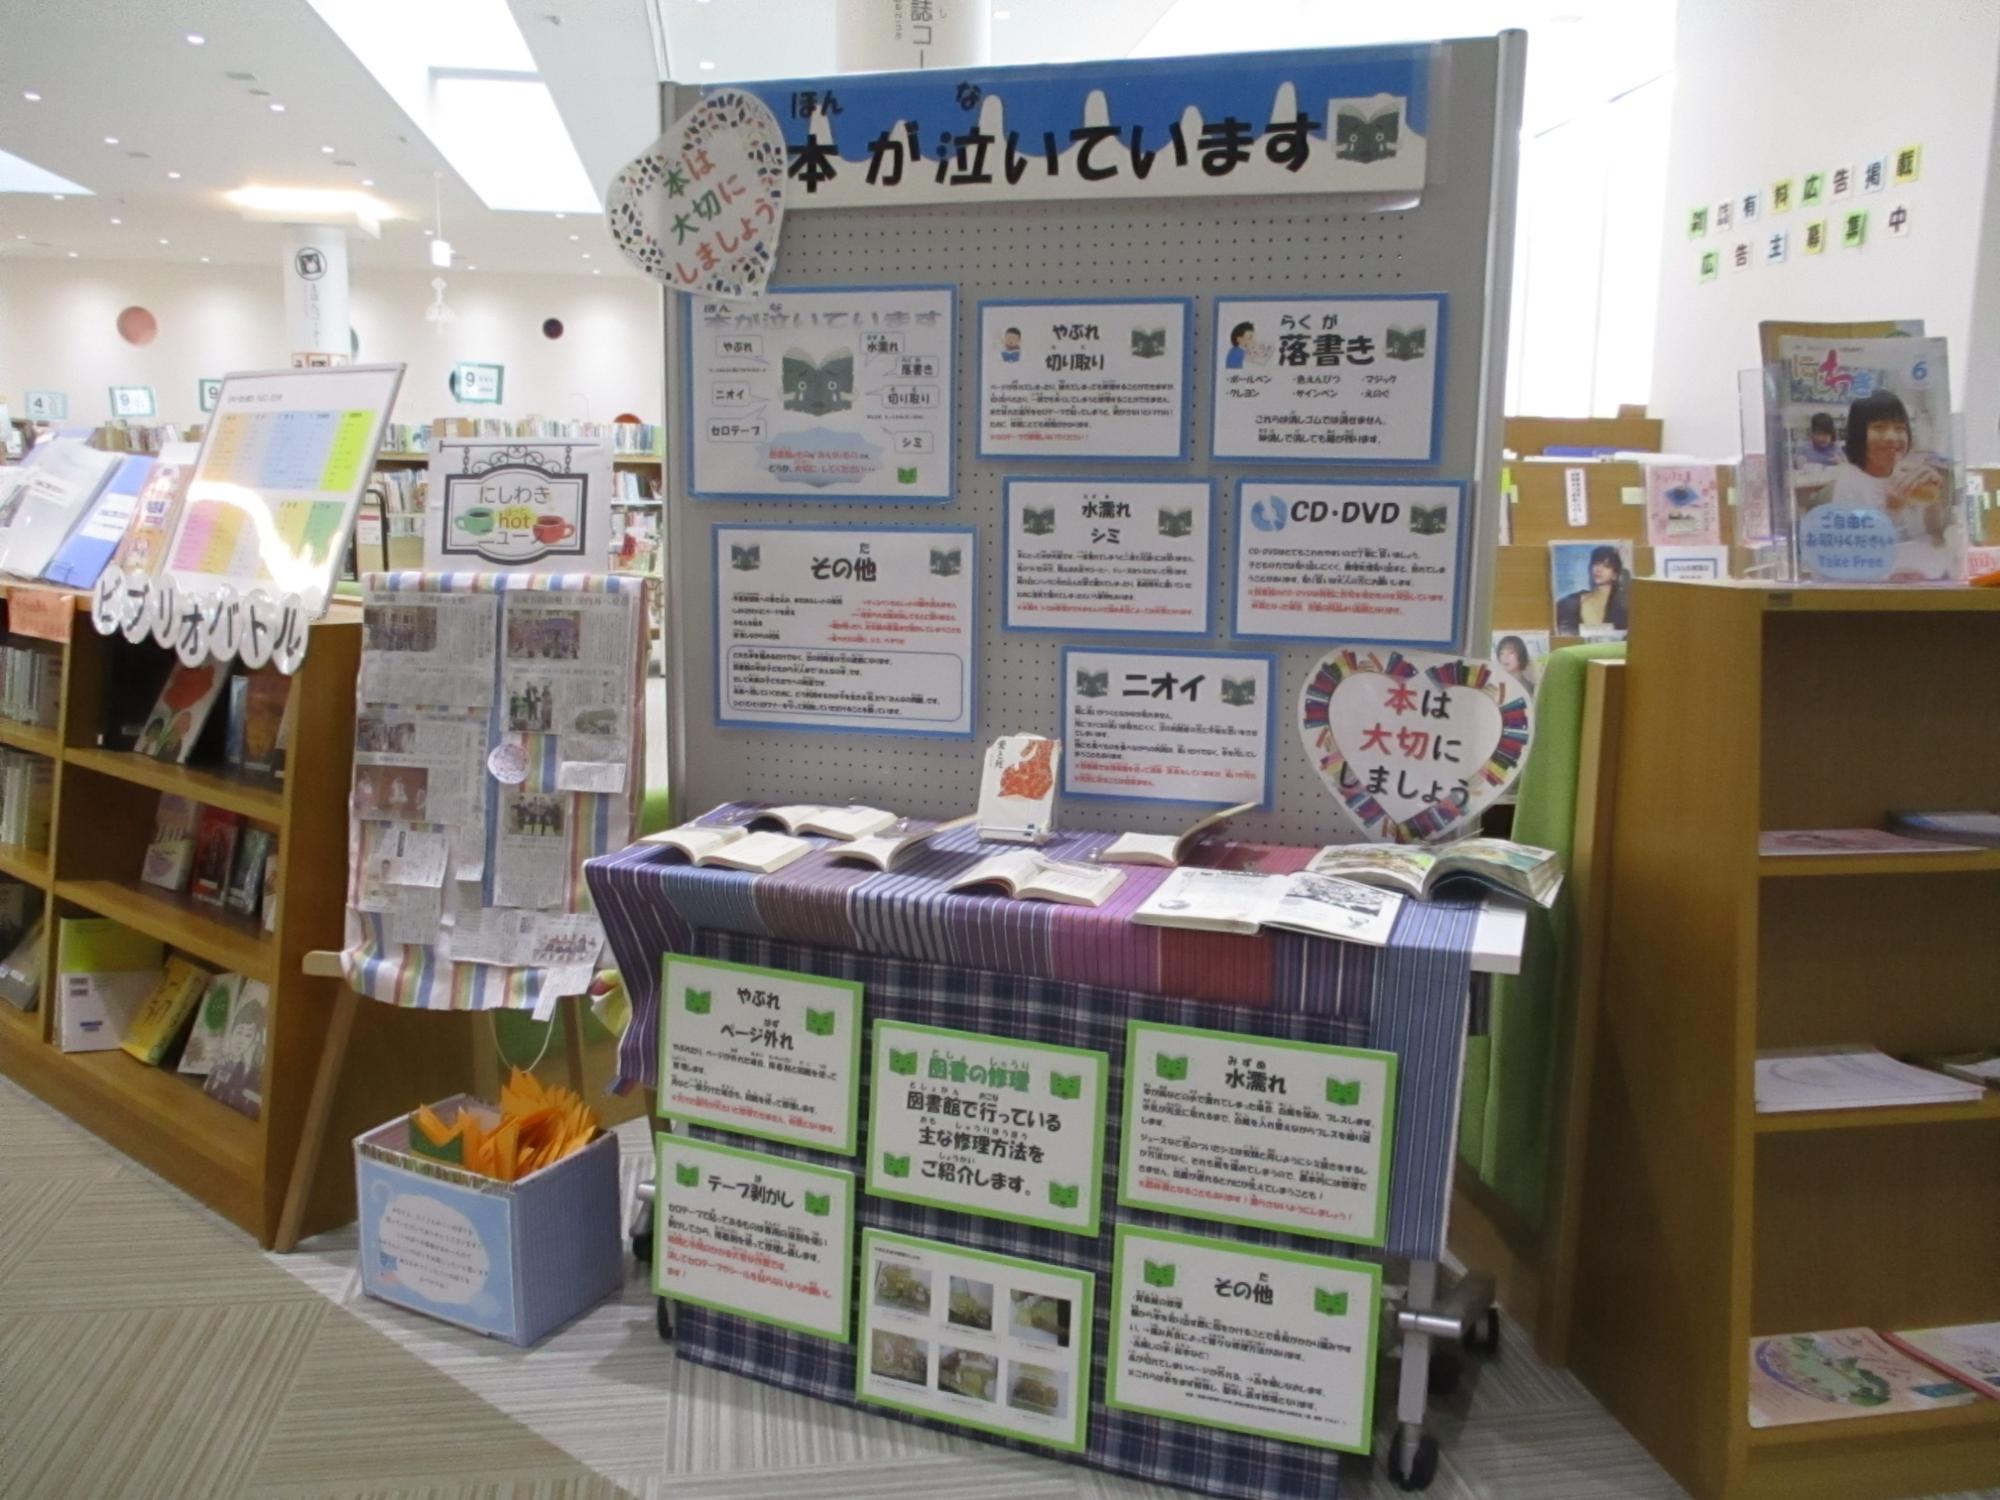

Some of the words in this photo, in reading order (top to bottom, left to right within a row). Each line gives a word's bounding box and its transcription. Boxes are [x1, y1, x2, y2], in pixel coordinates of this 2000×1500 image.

[792, 90, 844, 119] ほん
[786, 117, 1321, 193] 本が泣いています
[663, 149, 715, 199] 本は
[671, 174, 746, 245] 大切に
[676, 198, 775, 284] しましょう
[1053, 324, 1099, 340] やぶれ
[1045, 354, 1104, 371] 切り取り
[1279, 333, 1375, 366] 落書き
[1911, 361, 1928, 380] 6
[716, 390, 744, 400] ニオイ
[499, 512, 530, 529] hot
[1082, 501, 1131, 518] 水濡れ
[1091, 528, 1120, 544] シミ
[811, 557, 877, 582] その他
[1123, 672, 1205, 701] ニオイ
[1384, 683, 1452, 719] 本は
[1360, 723, 1461, 762] 大切に
[1340, 761, 1470, 807] しましょう
[737, 987, 781, 1010] やぶれ
[720, 1023, 794, 1050] ページ外れ
[928, 1058, 1030, 1092] 図書の修理
[1225, 1068, 1286, 1094] 水濡れ
[906, 1091, 1062, 1132] 図書館で行っている
[918, 1126, 1045, 1164] 主な修理方法を
[708, 1175, 794, 1208] テープ剥がし
[921, 1160, 1032, 1197] ご紹介します。
[1215, 1277, 1274, 1306] その他
